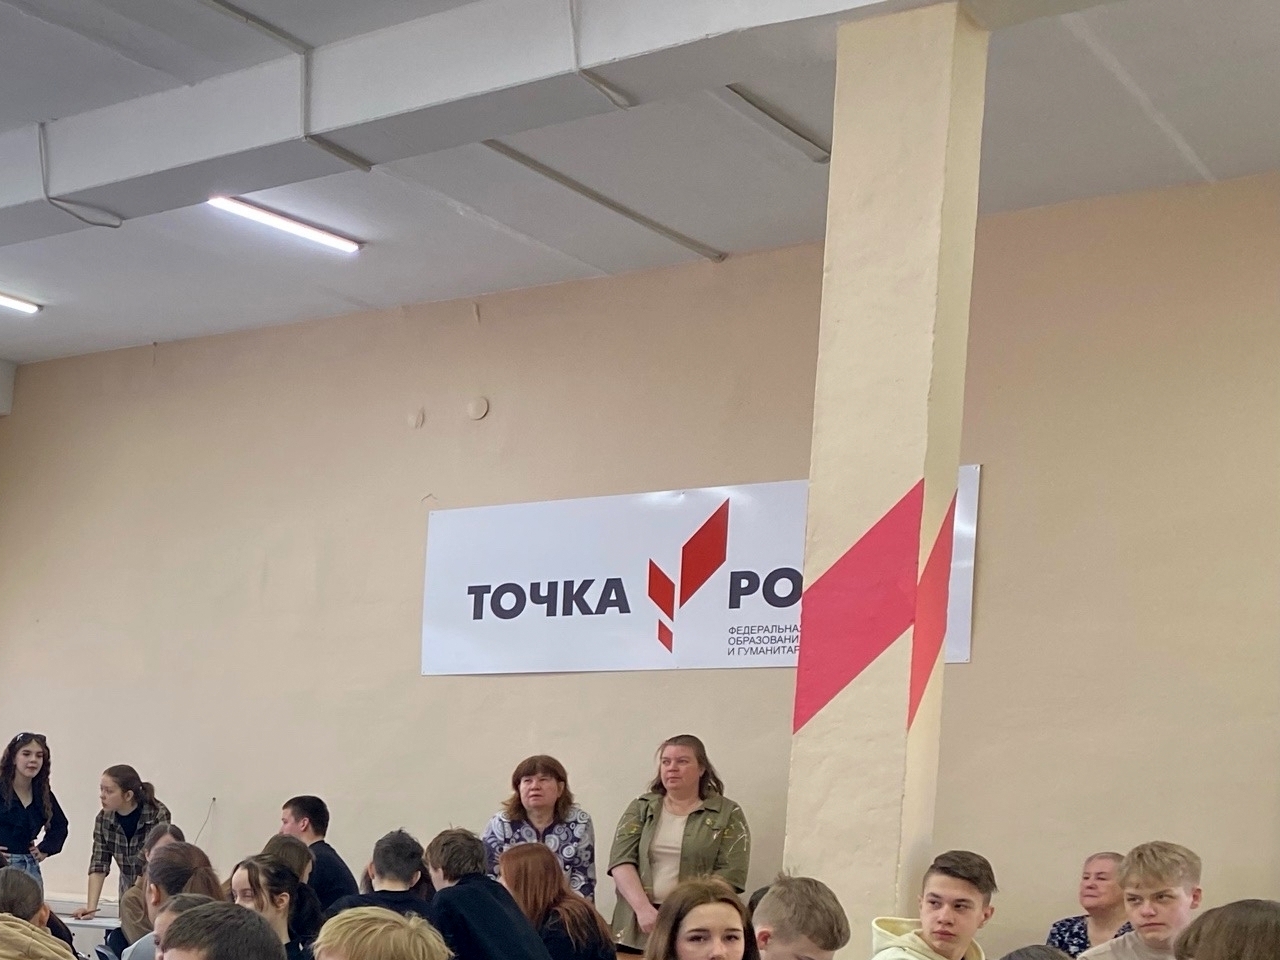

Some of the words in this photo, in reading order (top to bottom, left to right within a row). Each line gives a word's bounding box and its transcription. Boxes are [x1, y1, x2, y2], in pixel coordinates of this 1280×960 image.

[467, 577, 631, 620] ТОЧКА
[729, 567, 803, 609] РО
[728, 624, 801, 635] ФЕДЕРАЛЬНА
[728, 635, 799, 646] ОБРАЗОВАНИ
[727, 647, 735, 656] И
